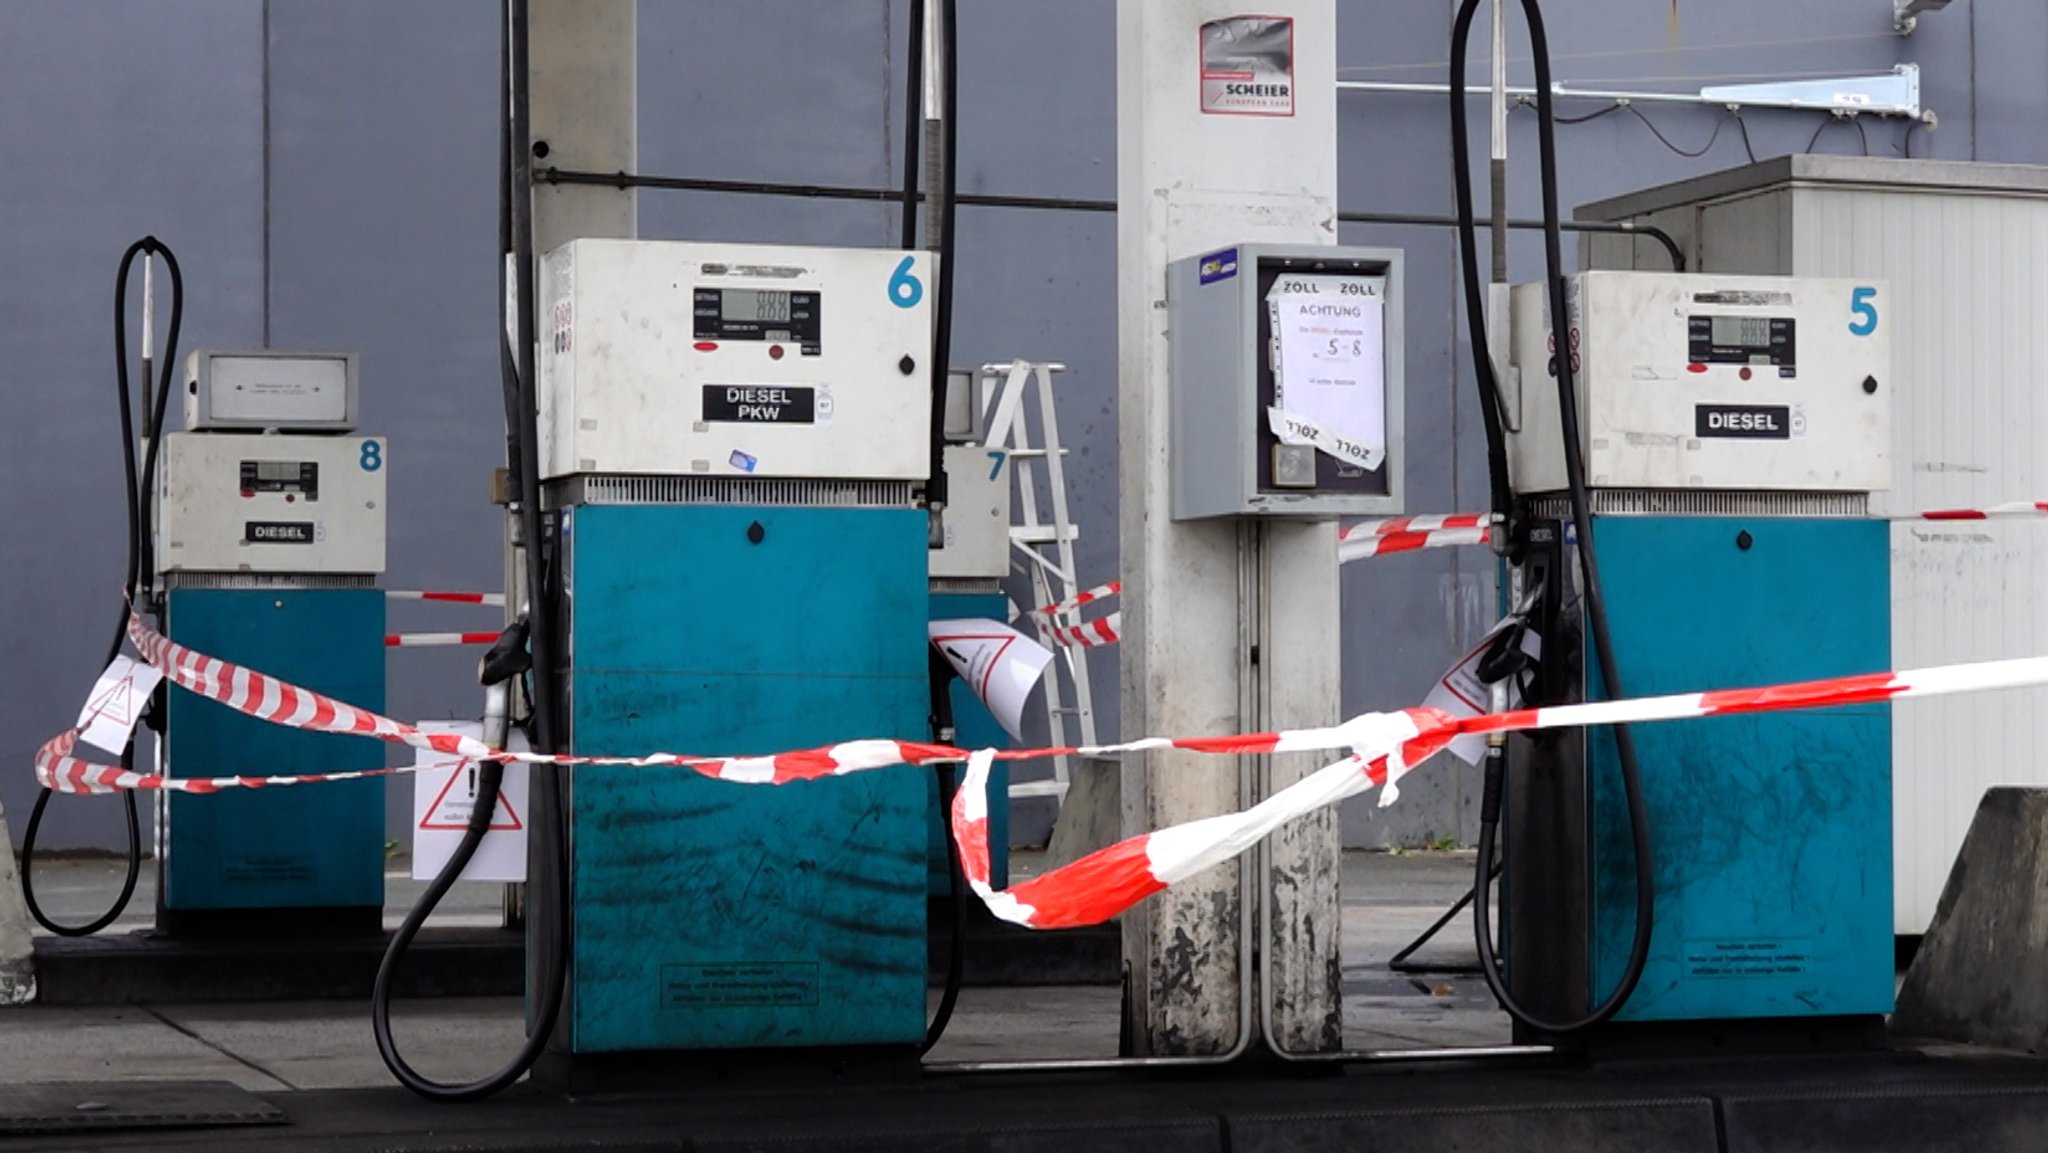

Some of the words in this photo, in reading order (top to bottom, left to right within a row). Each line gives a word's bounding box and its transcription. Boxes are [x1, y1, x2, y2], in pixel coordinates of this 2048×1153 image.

[1225, 84, 1289, 97] SCHEIER
[887, 255, 923, 309] 6
[1283, 281, 1320, 294] ZOLL
[1340, 283, 1376, 296] ZOLL
[1299, 304, 1362, 318] ACHTUNG
[1848, 286, 1878, 336] 5
[726, 387, 792, 404] DIESEL
[738, 405, 780, 420] PKW
[1707, 412, 1779, 430] DIESEL
[359, 439, 382, 472] 8
[986, 451, 1006, 481] 7
[254, 525, 306, 539] DIESEL
